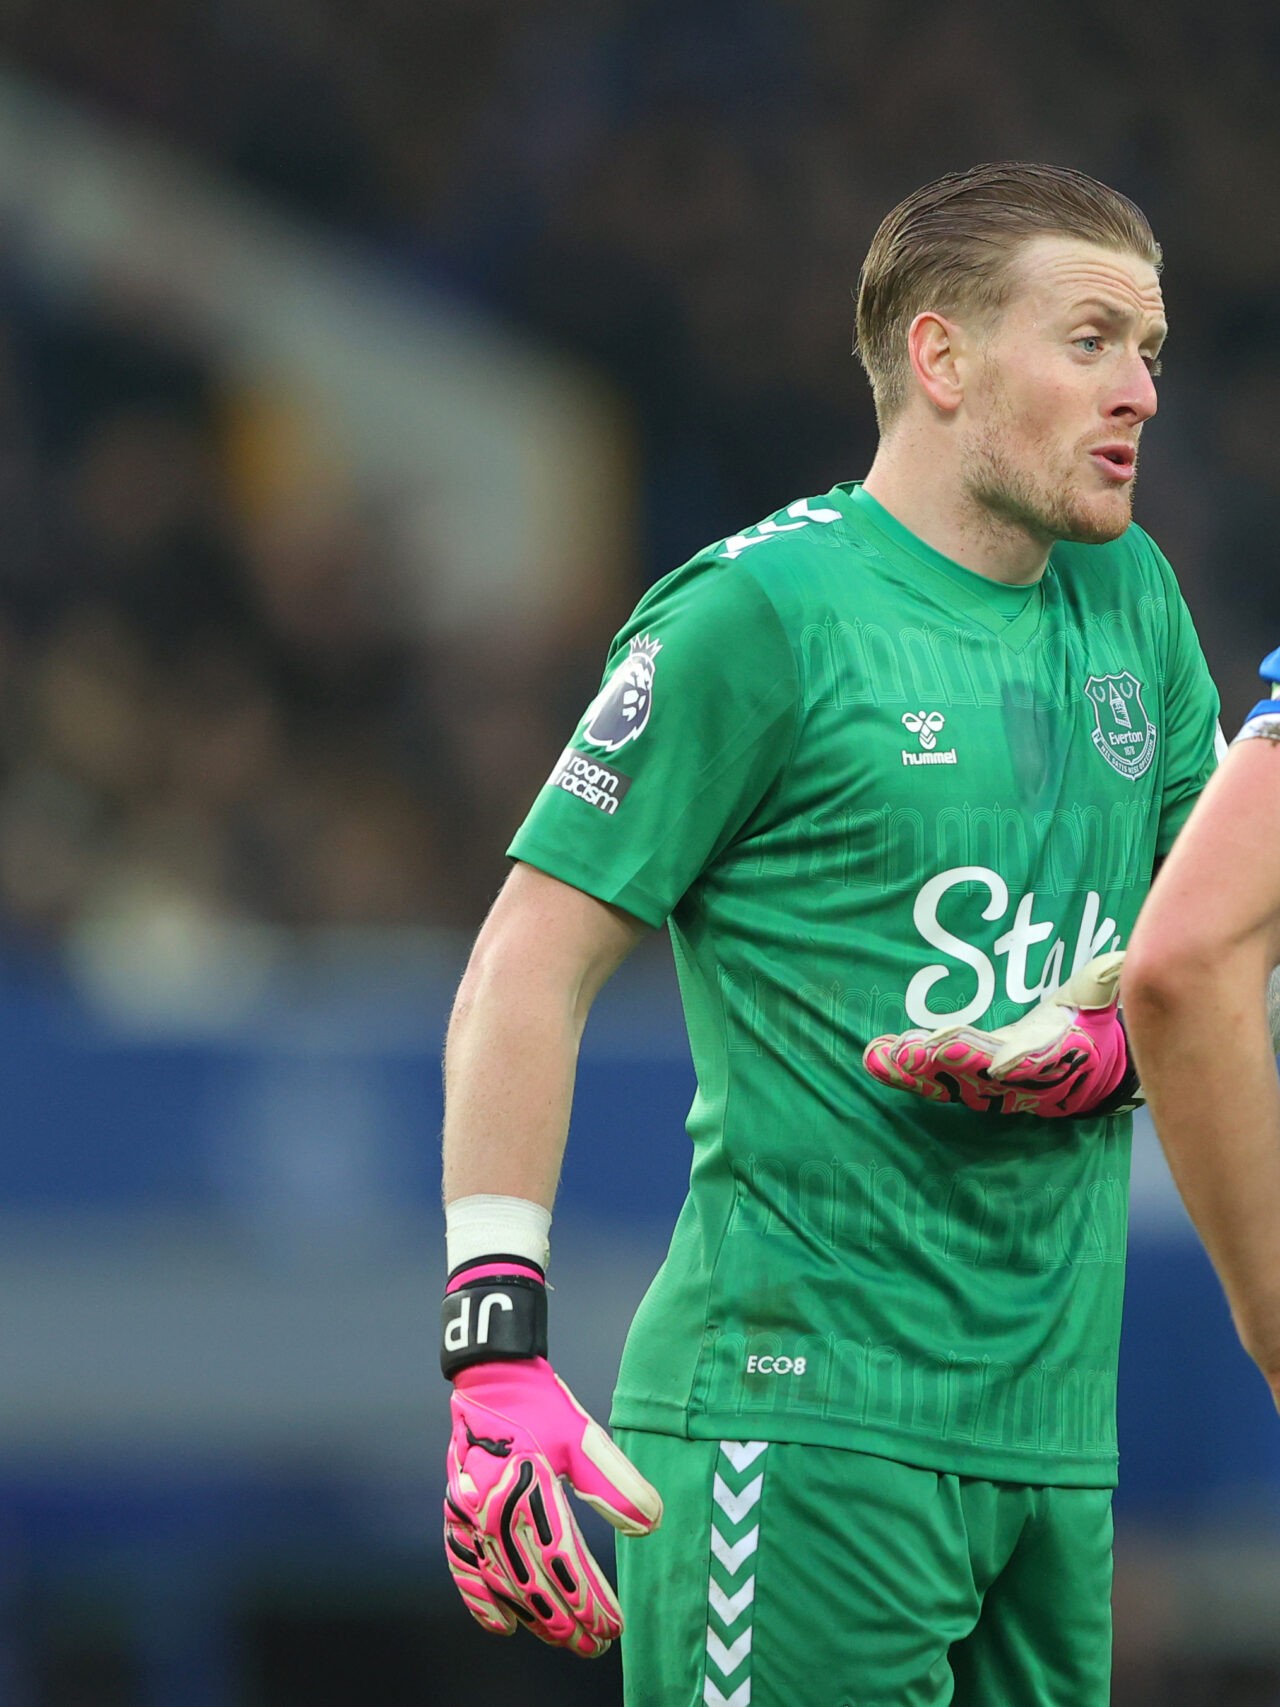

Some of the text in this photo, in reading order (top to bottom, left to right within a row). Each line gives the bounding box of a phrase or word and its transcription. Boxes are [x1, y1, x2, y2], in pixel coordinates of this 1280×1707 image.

[1108, 730, 1144, 746] Everton
[567, 756, 619, 793] room
[901, 748, 958, 766] hummel
[556, 771, 619, 815] racism
[905, 866, 1122, 1031] Stak
[444, 1292, 513, 1352] JP
[746, 1355, 807, 1376] ECO8
